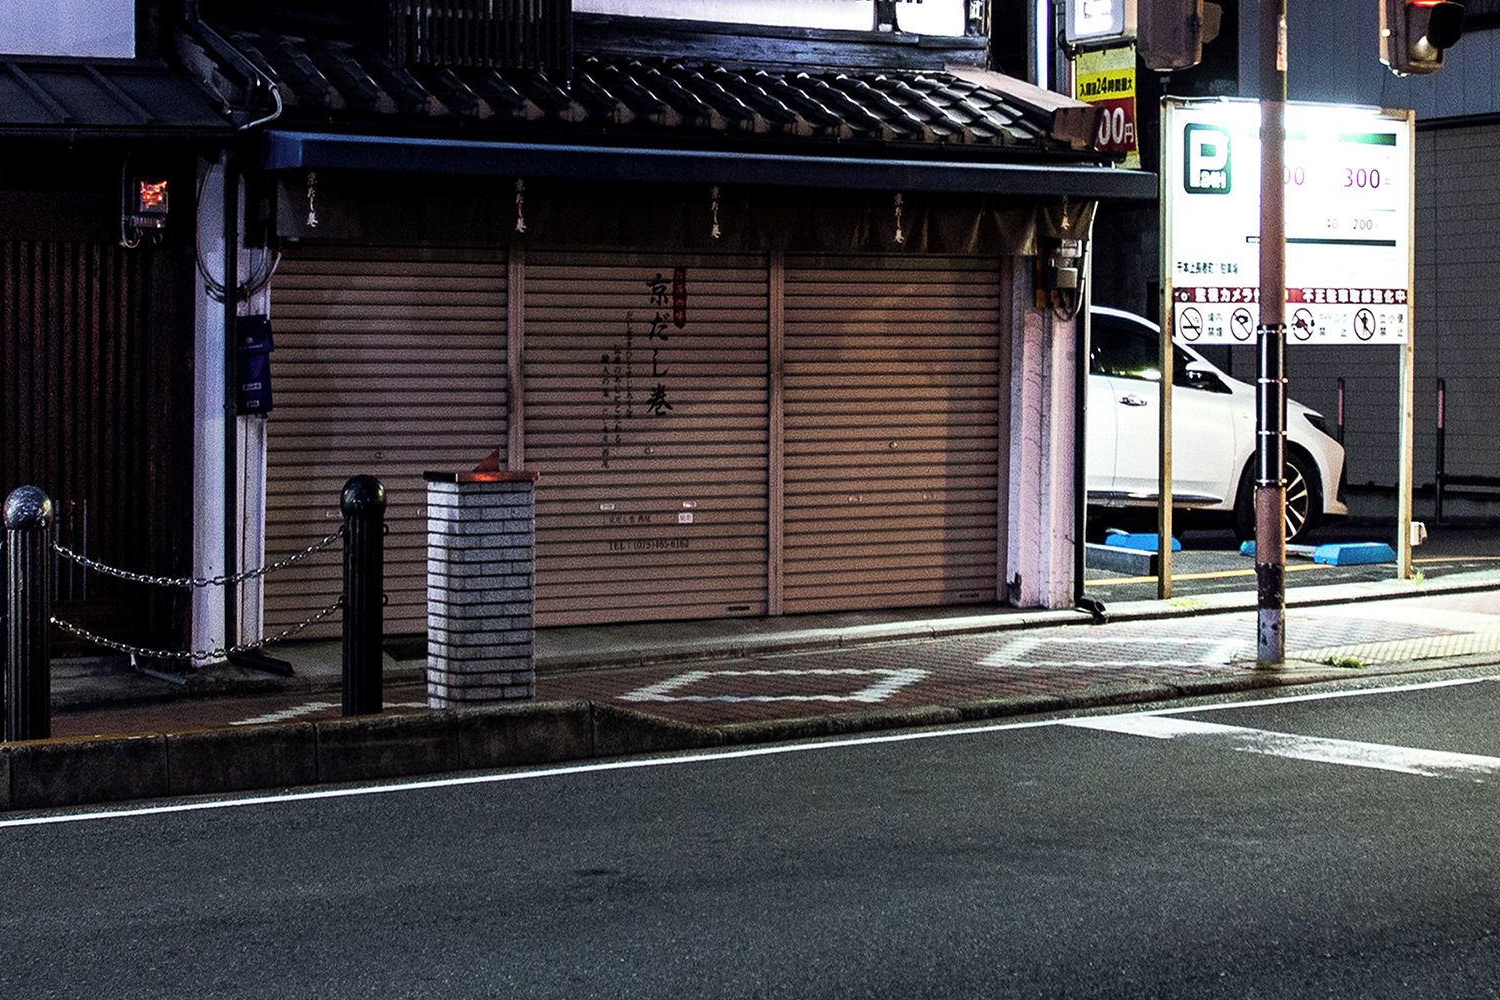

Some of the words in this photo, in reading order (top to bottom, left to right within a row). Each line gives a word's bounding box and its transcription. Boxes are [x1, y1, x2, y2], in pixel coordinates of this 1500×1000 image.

[1098, 107, 1134, 145] 00円
[1190, 130, 1228, 187] P
[1343, 168, 1380, 189] 300
[646, 273, 673, 416] 京だし巻
